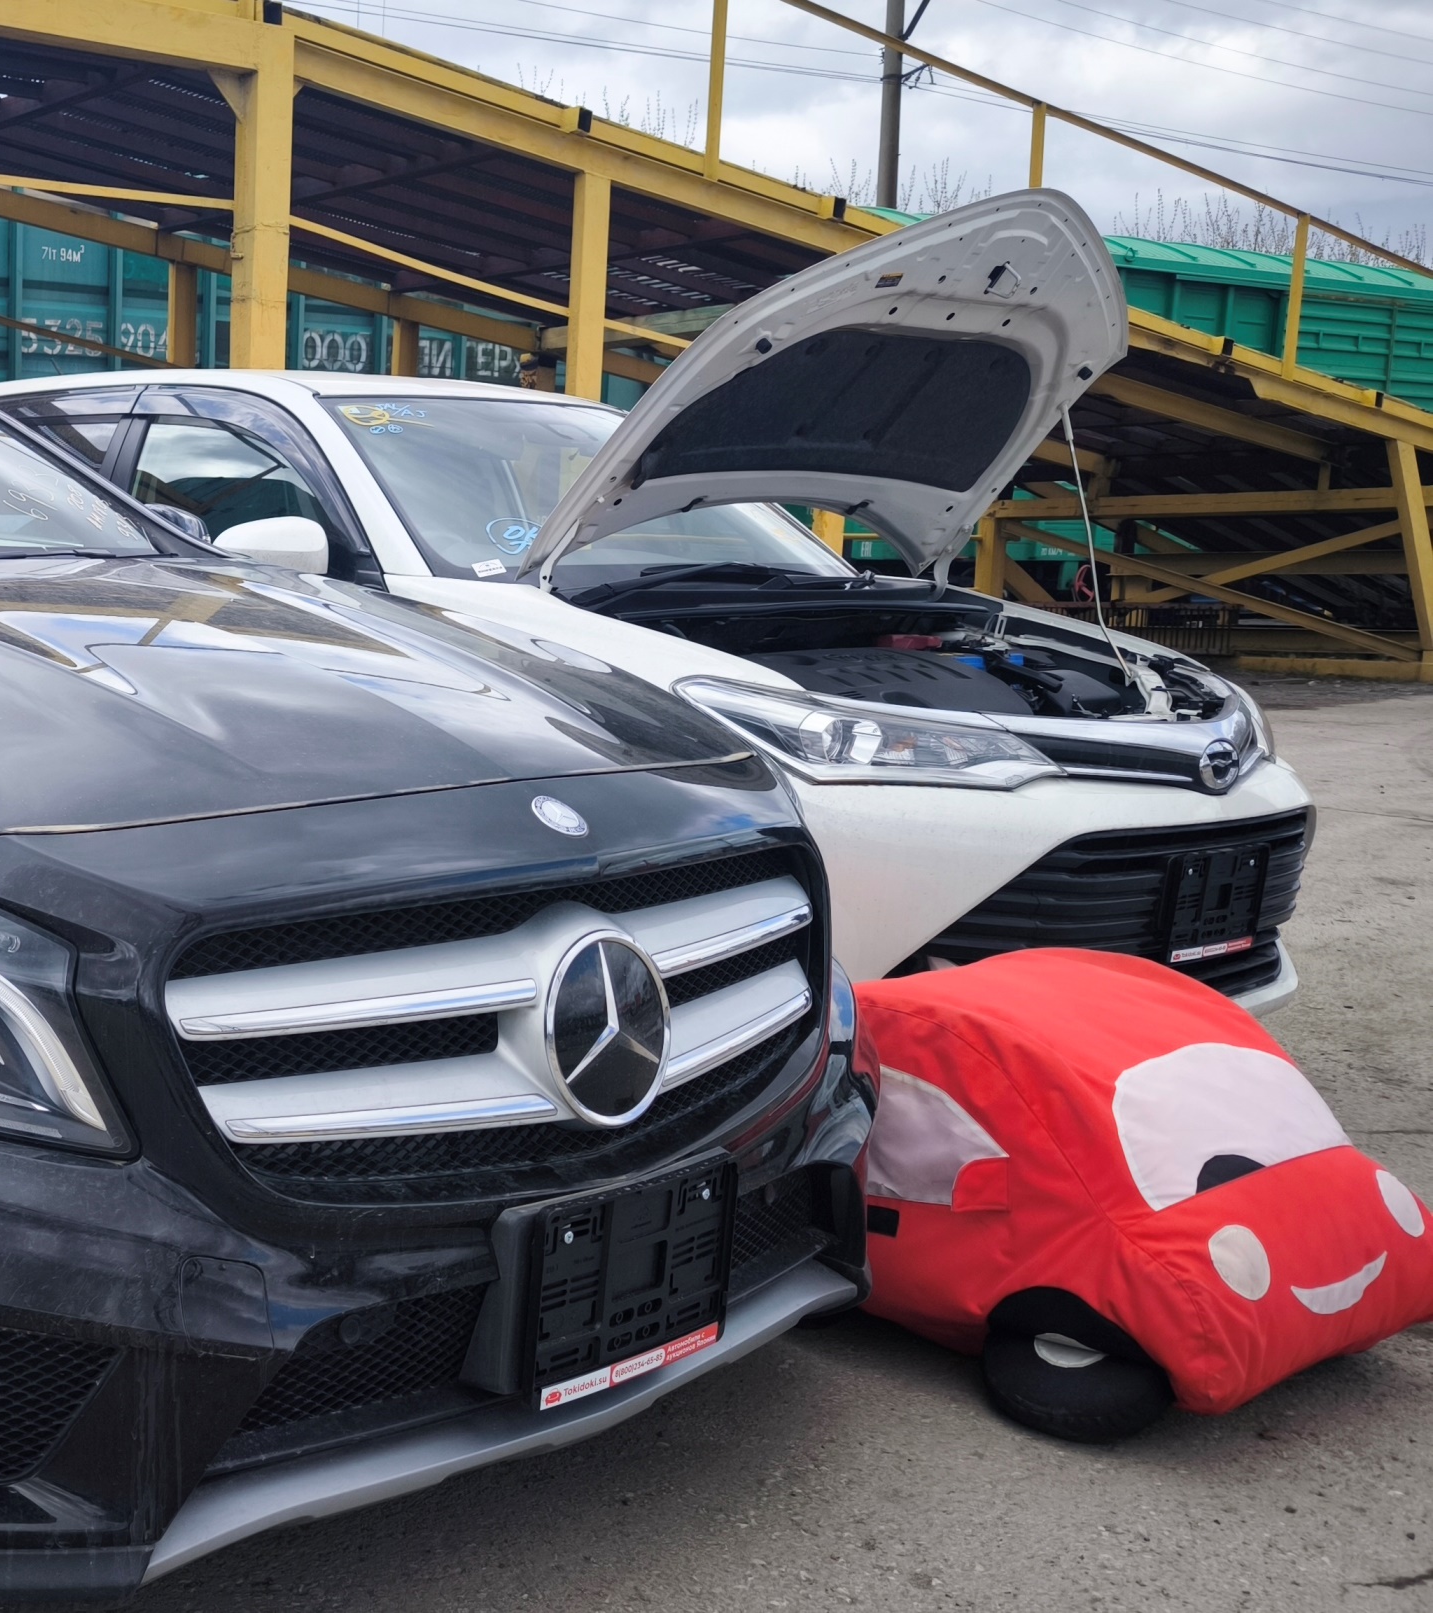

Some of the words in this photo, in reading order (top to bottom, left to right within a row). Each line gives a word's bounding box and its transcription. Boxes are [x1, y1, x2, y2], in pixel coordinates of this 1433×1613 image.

[667, 1334, 701, 1353] Автомобили
[614, 1352, 664, 1378] 8(800)234-65-85
[563, 1375, 608, 1397] Tokidoki.su
